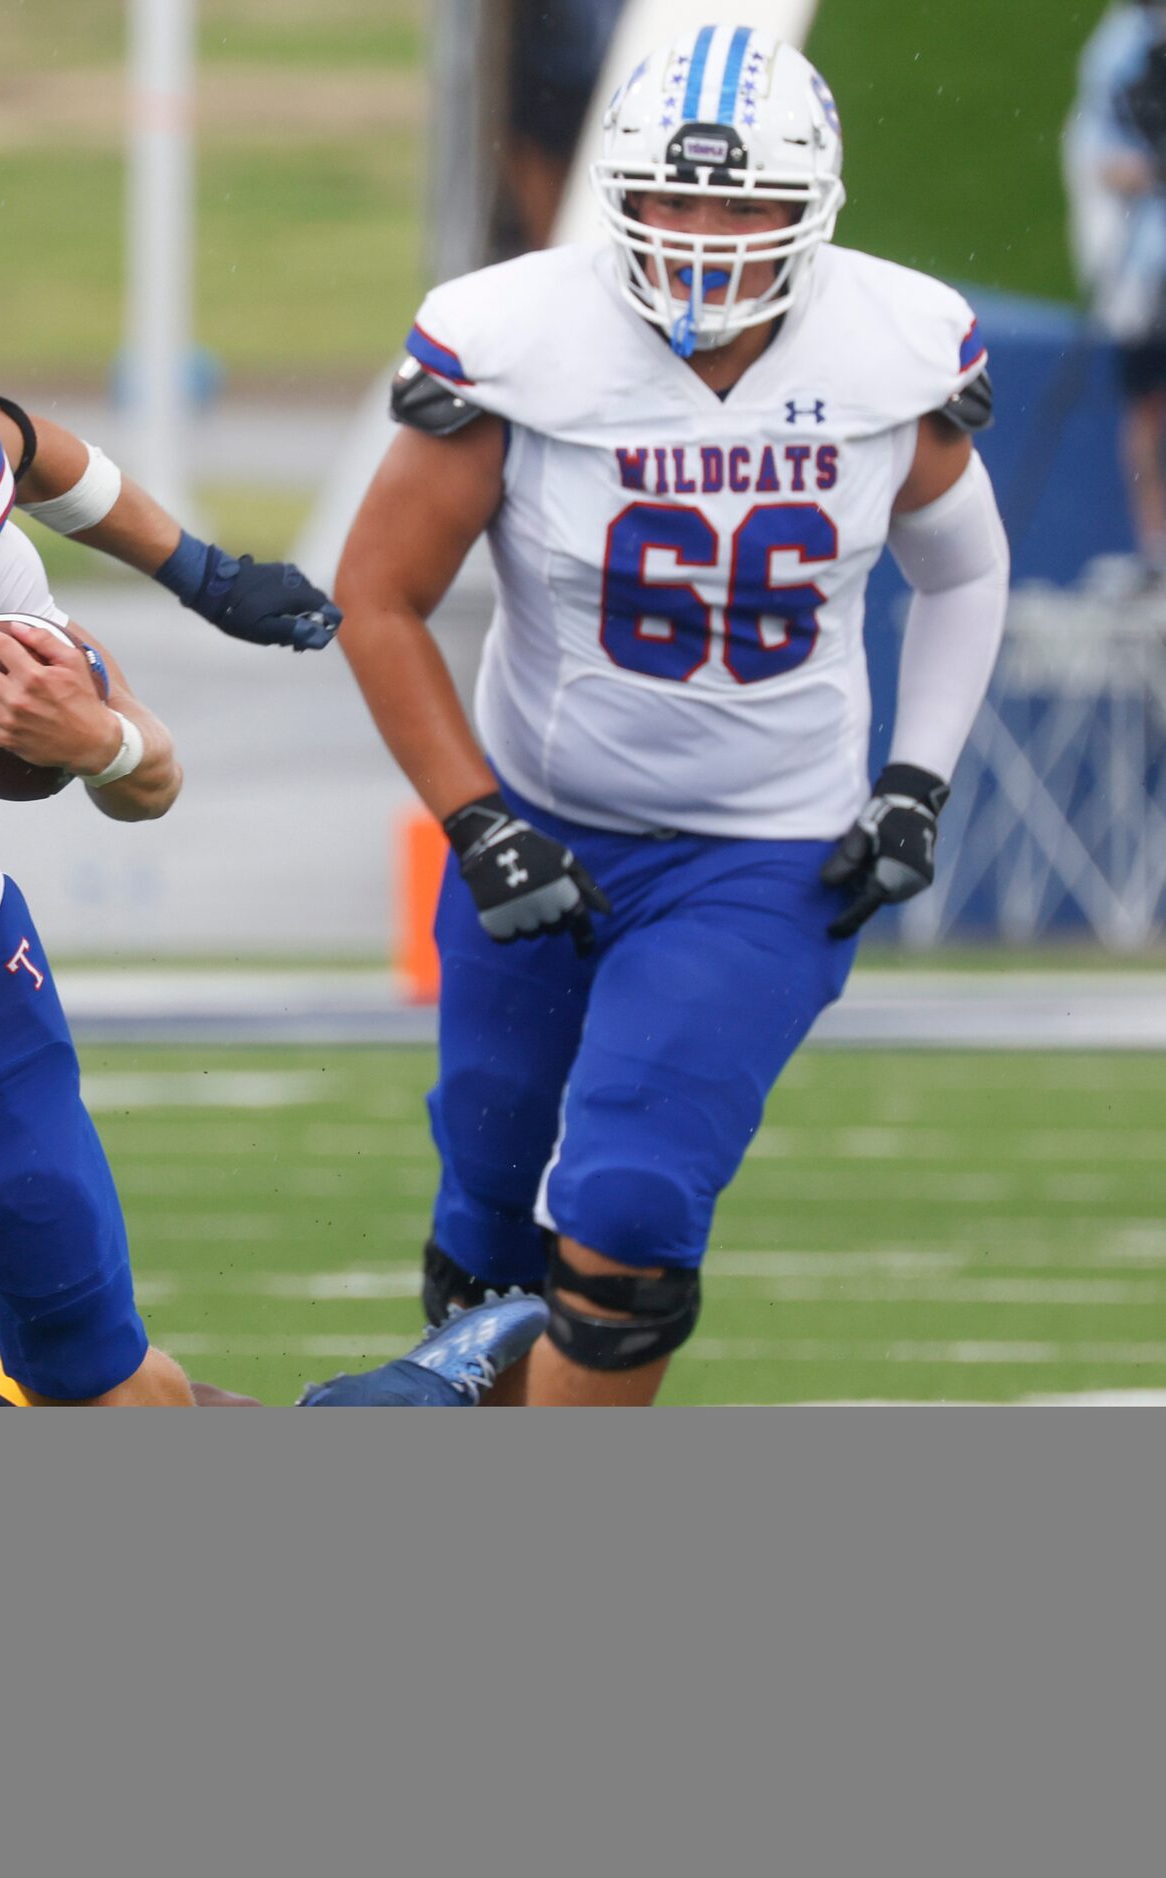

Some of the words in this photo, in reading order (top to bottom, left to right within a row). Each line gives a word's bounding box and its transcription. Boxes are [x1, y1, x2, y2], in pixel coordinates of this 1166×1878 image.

[615, 444, 840, 497] WILDCATS
[599, 501, 839, 686] 66
[4, 936, 45, 992] T
